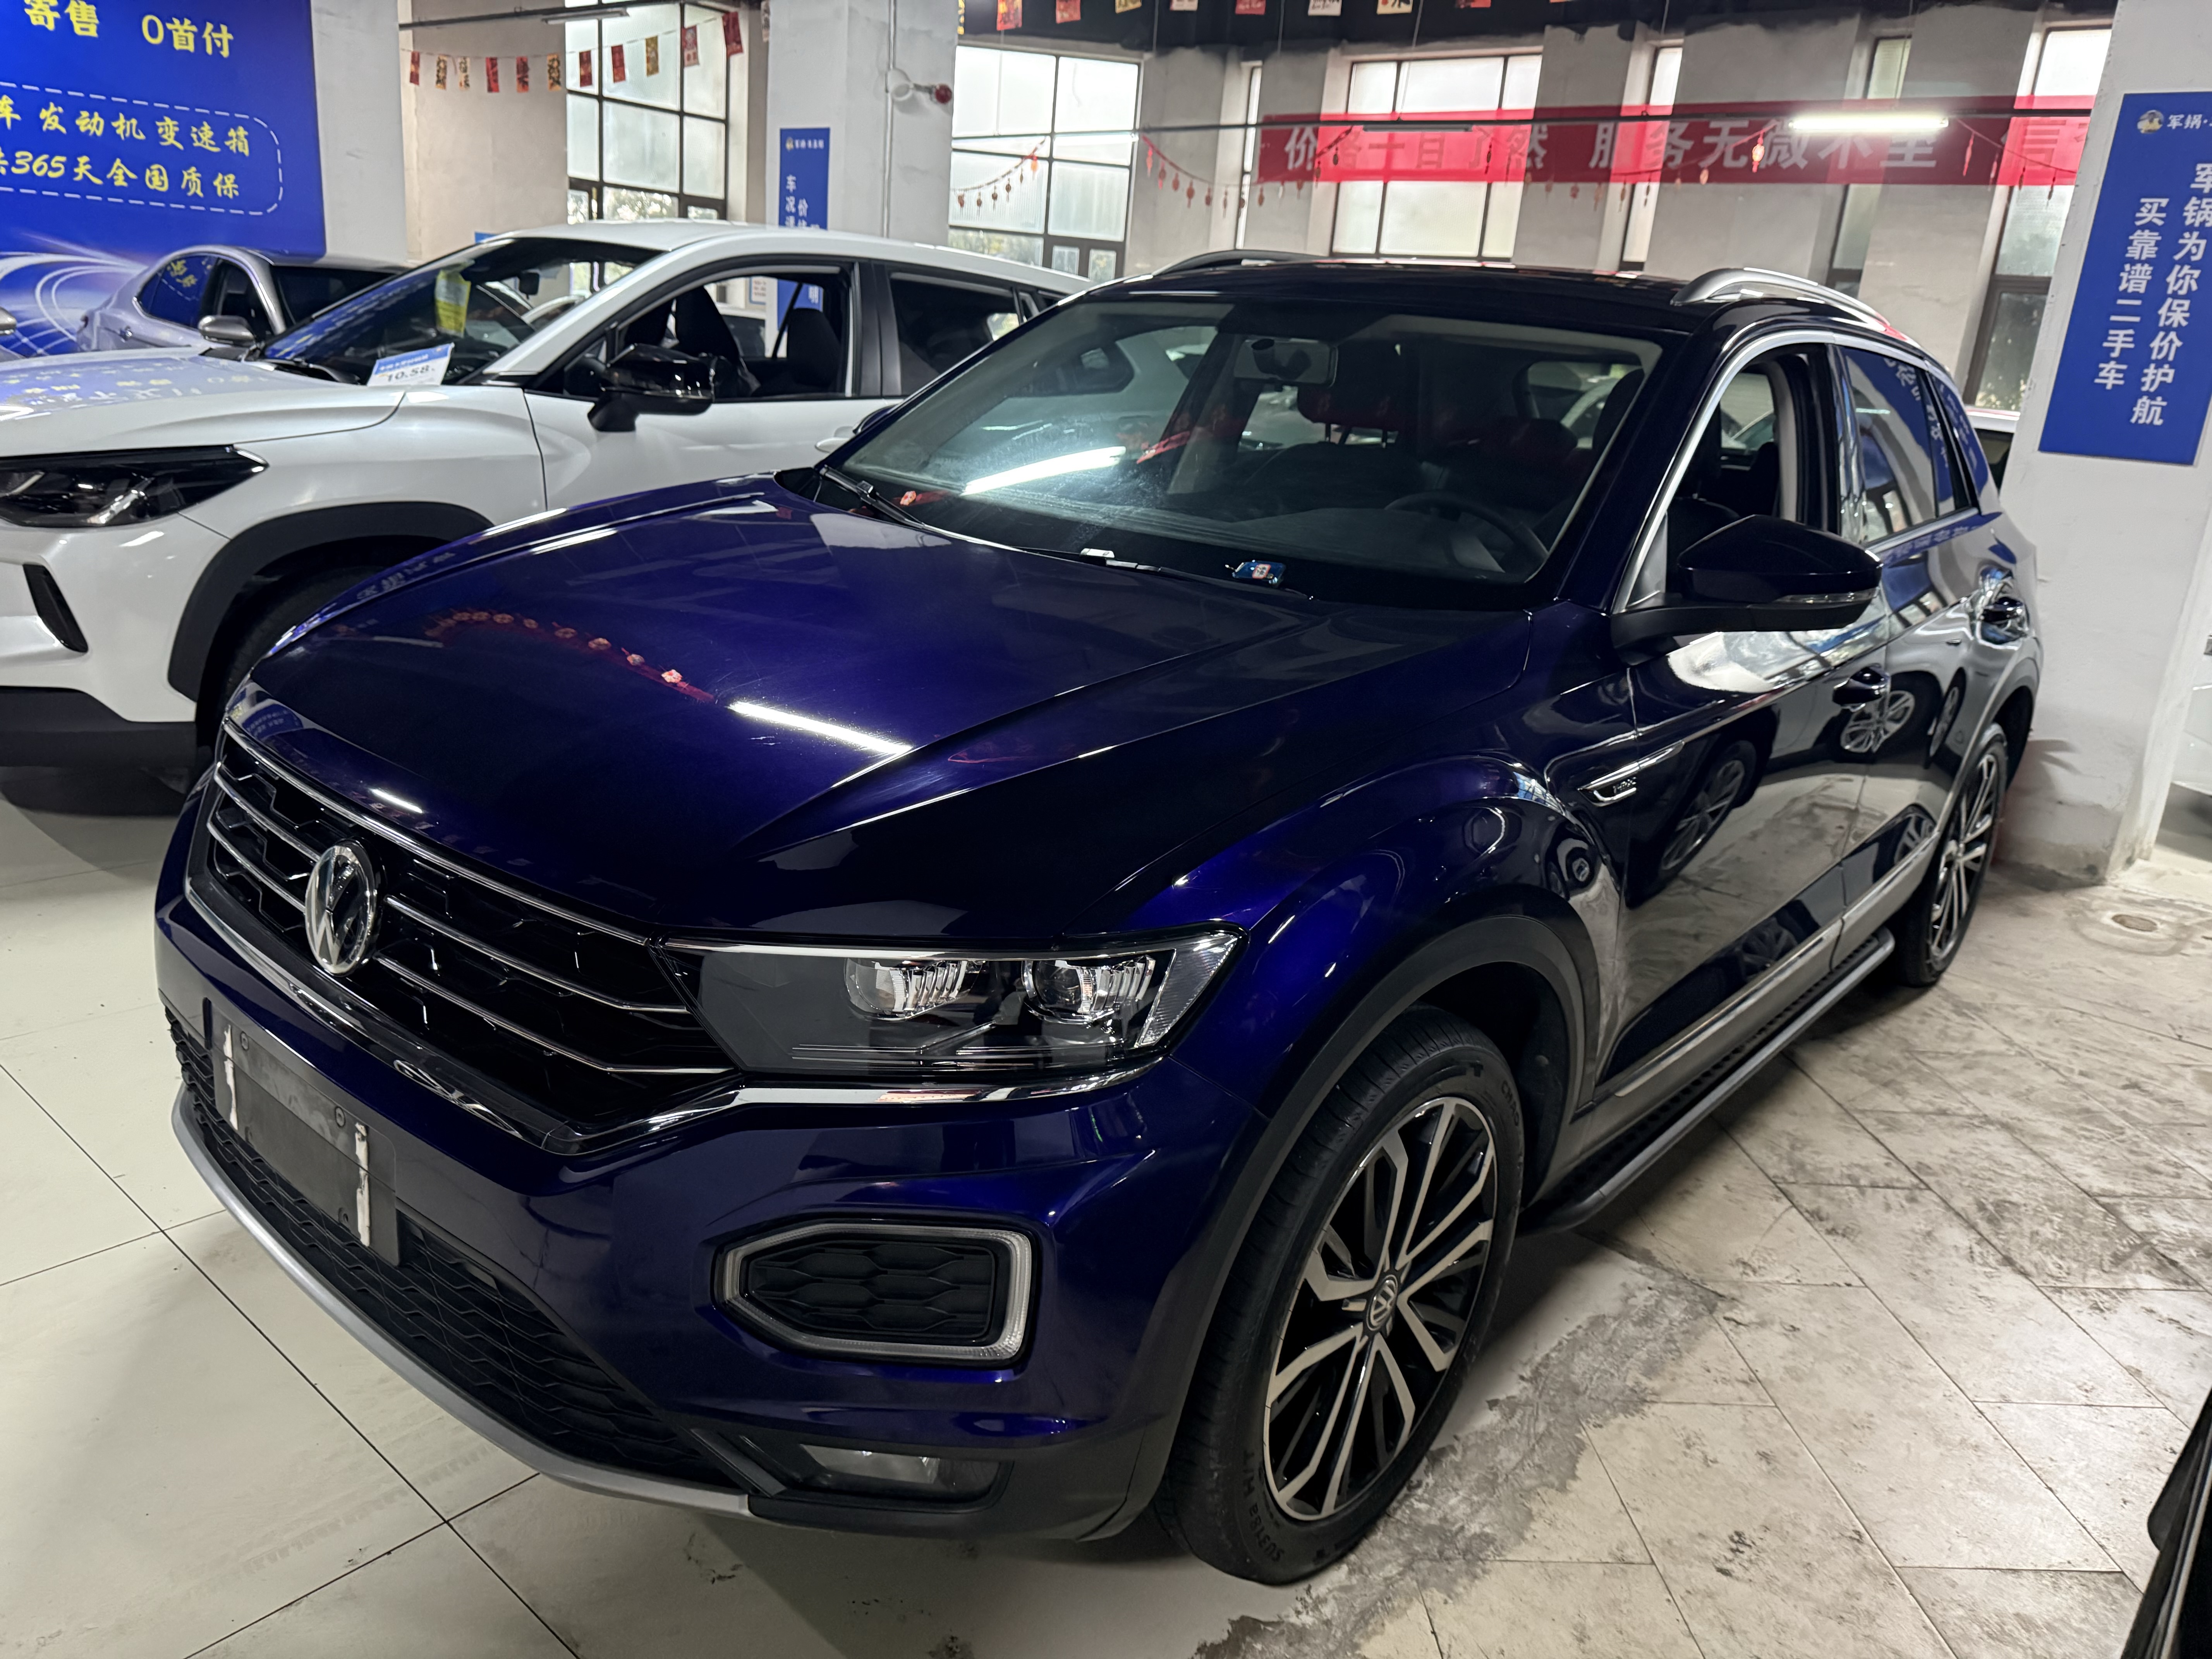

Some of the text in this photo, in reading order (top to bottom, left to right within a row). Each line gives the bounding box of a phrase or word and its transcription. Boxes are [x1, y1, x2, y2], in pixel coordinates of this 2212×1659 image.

[24, 0, 99, 38] 寄售
[2094, 198, 2169, 390] 买靠谱二手车
[2130, 163, 2212, 426] 军锅为你保价护航
